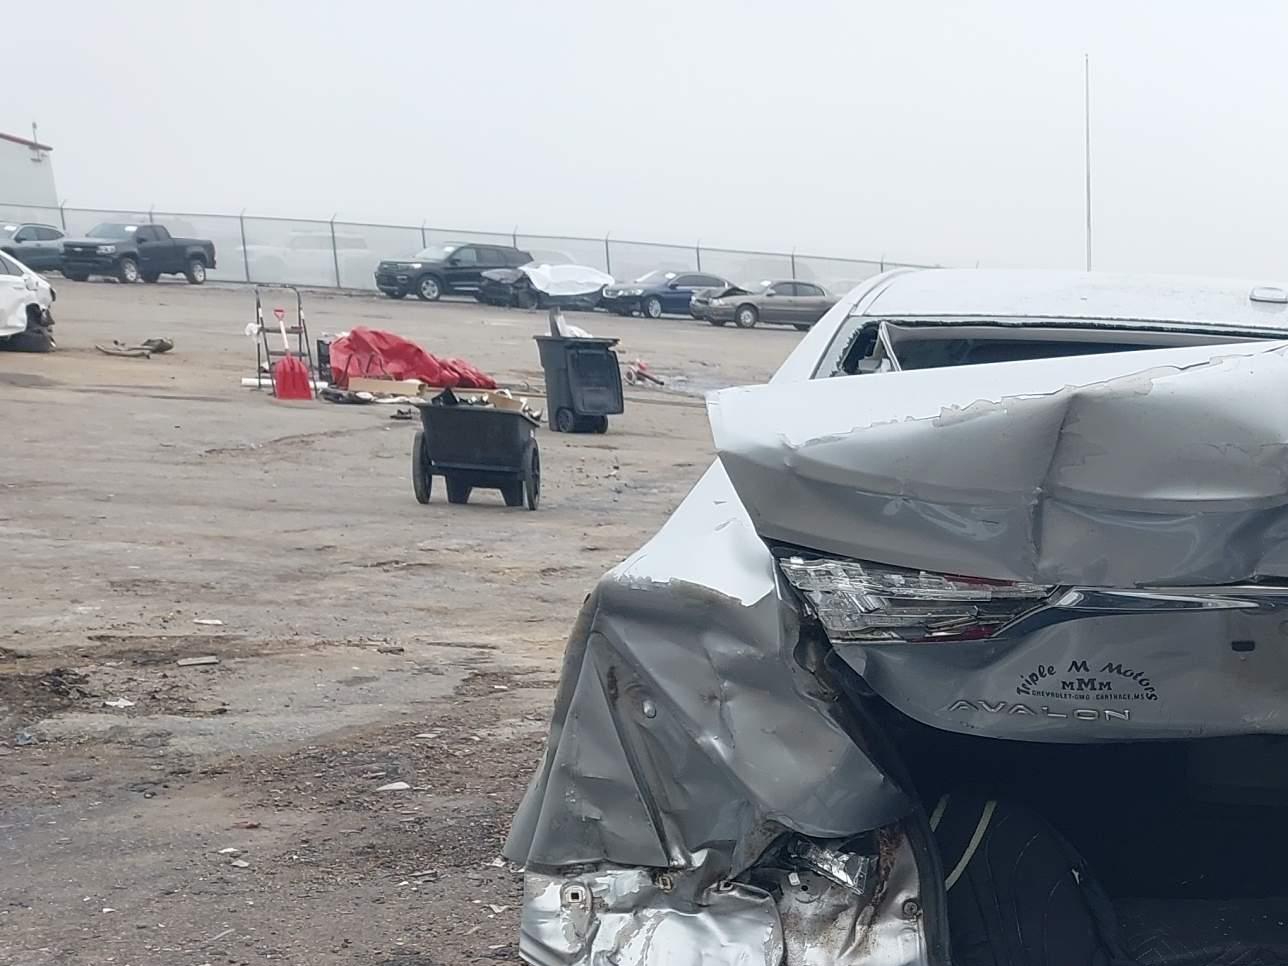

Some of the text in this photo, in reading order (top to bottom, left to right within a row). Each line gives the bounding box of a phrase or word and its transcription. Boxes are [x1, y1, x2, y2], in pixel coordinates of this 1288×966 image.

[1016, 660, 1158, 701] Triple M Motors
[1060, 678, 1113, 691] MMM
[948, 700, 1131, 721] AVALON
